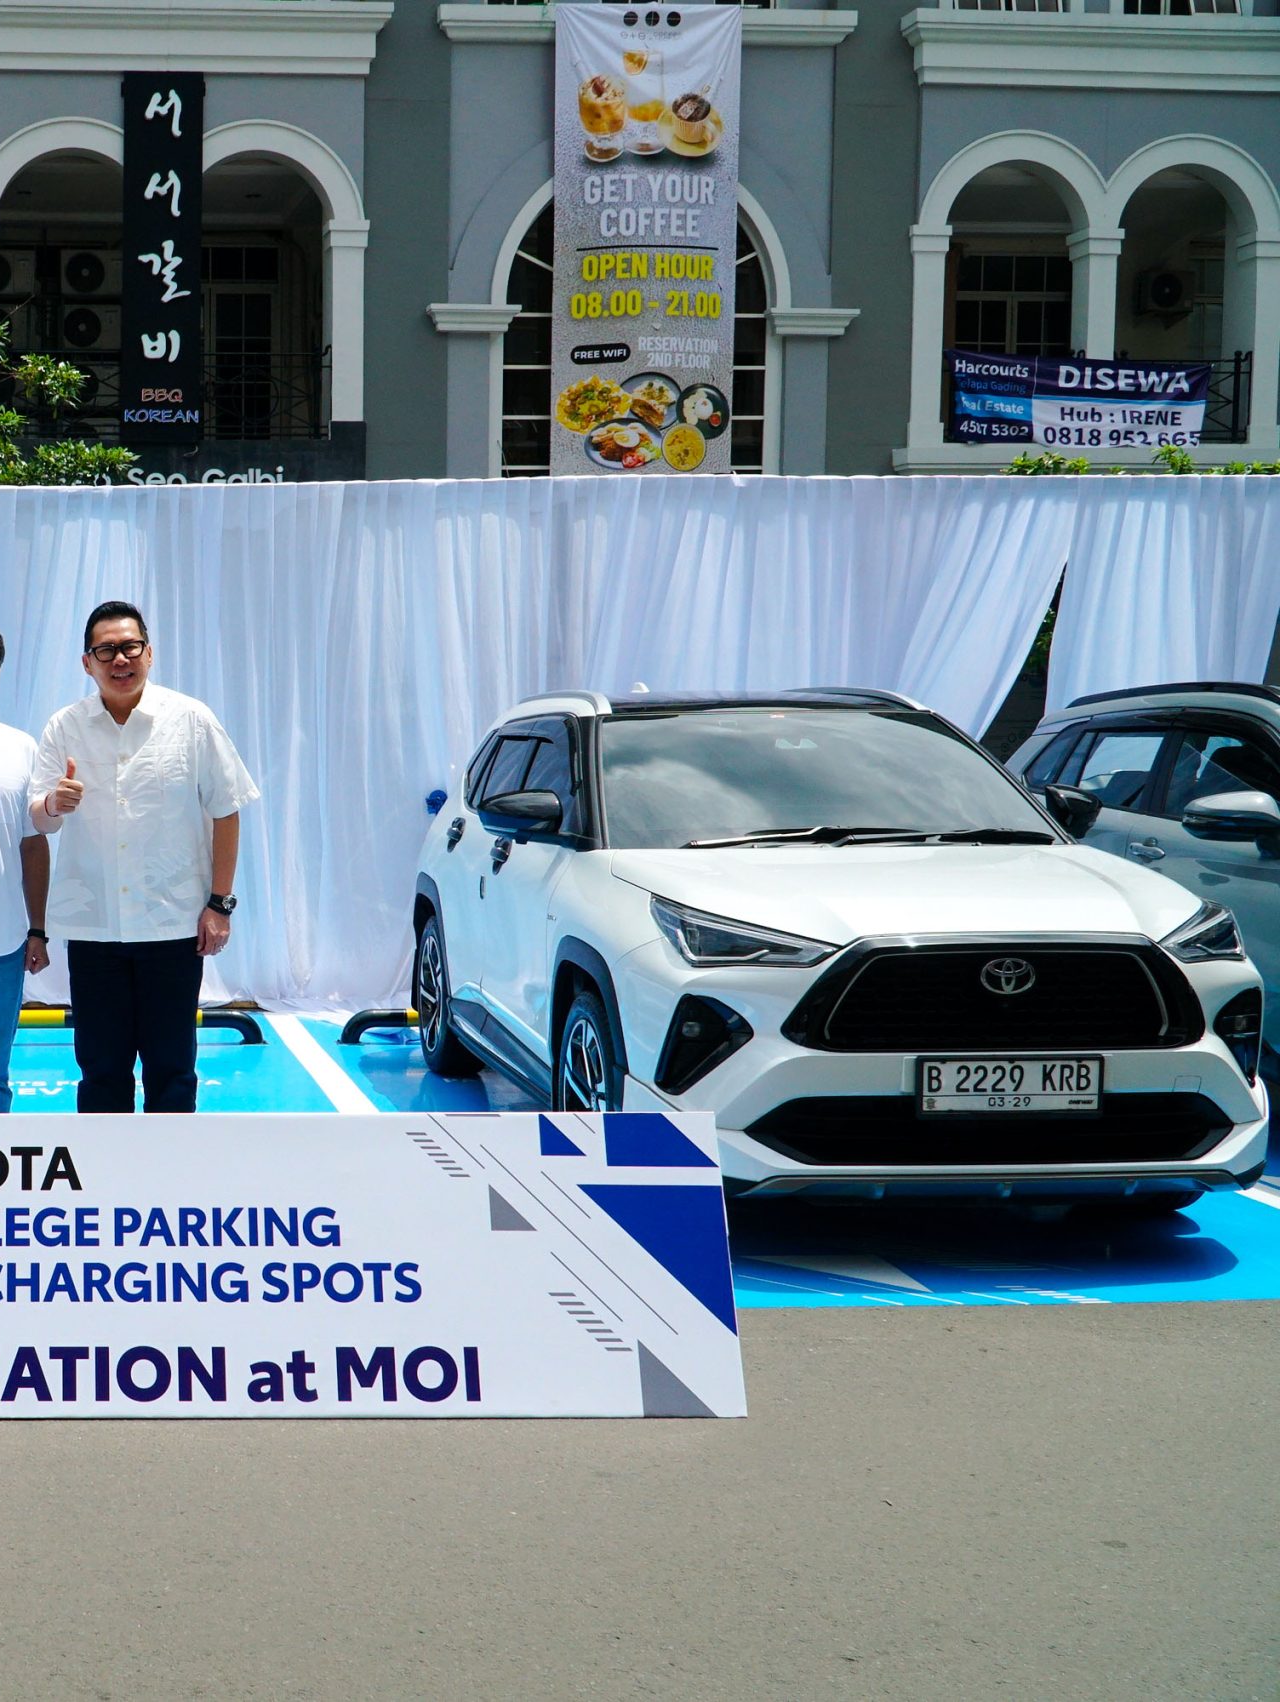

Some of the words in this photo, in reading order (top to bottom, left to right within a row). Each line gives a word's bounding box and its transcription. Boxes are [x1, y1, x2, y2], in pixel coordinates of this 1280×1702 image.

[583, 174, 638, 204] GET
[646, 174, 715, 205] YOUR
[136, 88, 192, 363] 서서갈비
[599, 207, 701, 238] COFFEE
[582, 252, 649, 282] OPEN
[654, 253, 714, 281] HOUR
[570, 288, 642, 320] 08.00
[665, 290, 721, 319] 21.00
[638, 336, 720, 354] RESERVATION
[574, 350, 600, 360] FREE
[647, 352, 671, 368] 2ND
[674, 354, 711, 369] FLOOR
[954, 359, 1029, 378] Harcourts
[959, 378, 989, 391] elapa
[990, 381, 1027, 394] Gading
[1058, 365, 1190, 393] DISEWA
[141, 388, 183, 403] BBQ
[123, 408, 199, 424] KOREAN
[984, 400, 1024, 415] Estate
[1060, 407, 1103, 423] Hub
[1121, 409, 1182, 426] IRENE
[991, 423, 1029, 436] 5302
[1043, 427, 1101, 446] 0818
[1108, 429, 1152, 446] 952
[927, 1066, 942, 1093] B
[955, 1065, 1025, 1093] 2229
[1041, 1064, 1092, 1092] KRB
[113, 1206, 341, 1248] PARKING
[261, 1261, 422, 1304] SPOTS
[247, 1349, 319, 1403] at
[335, 1345, 482, 1403] MOI
